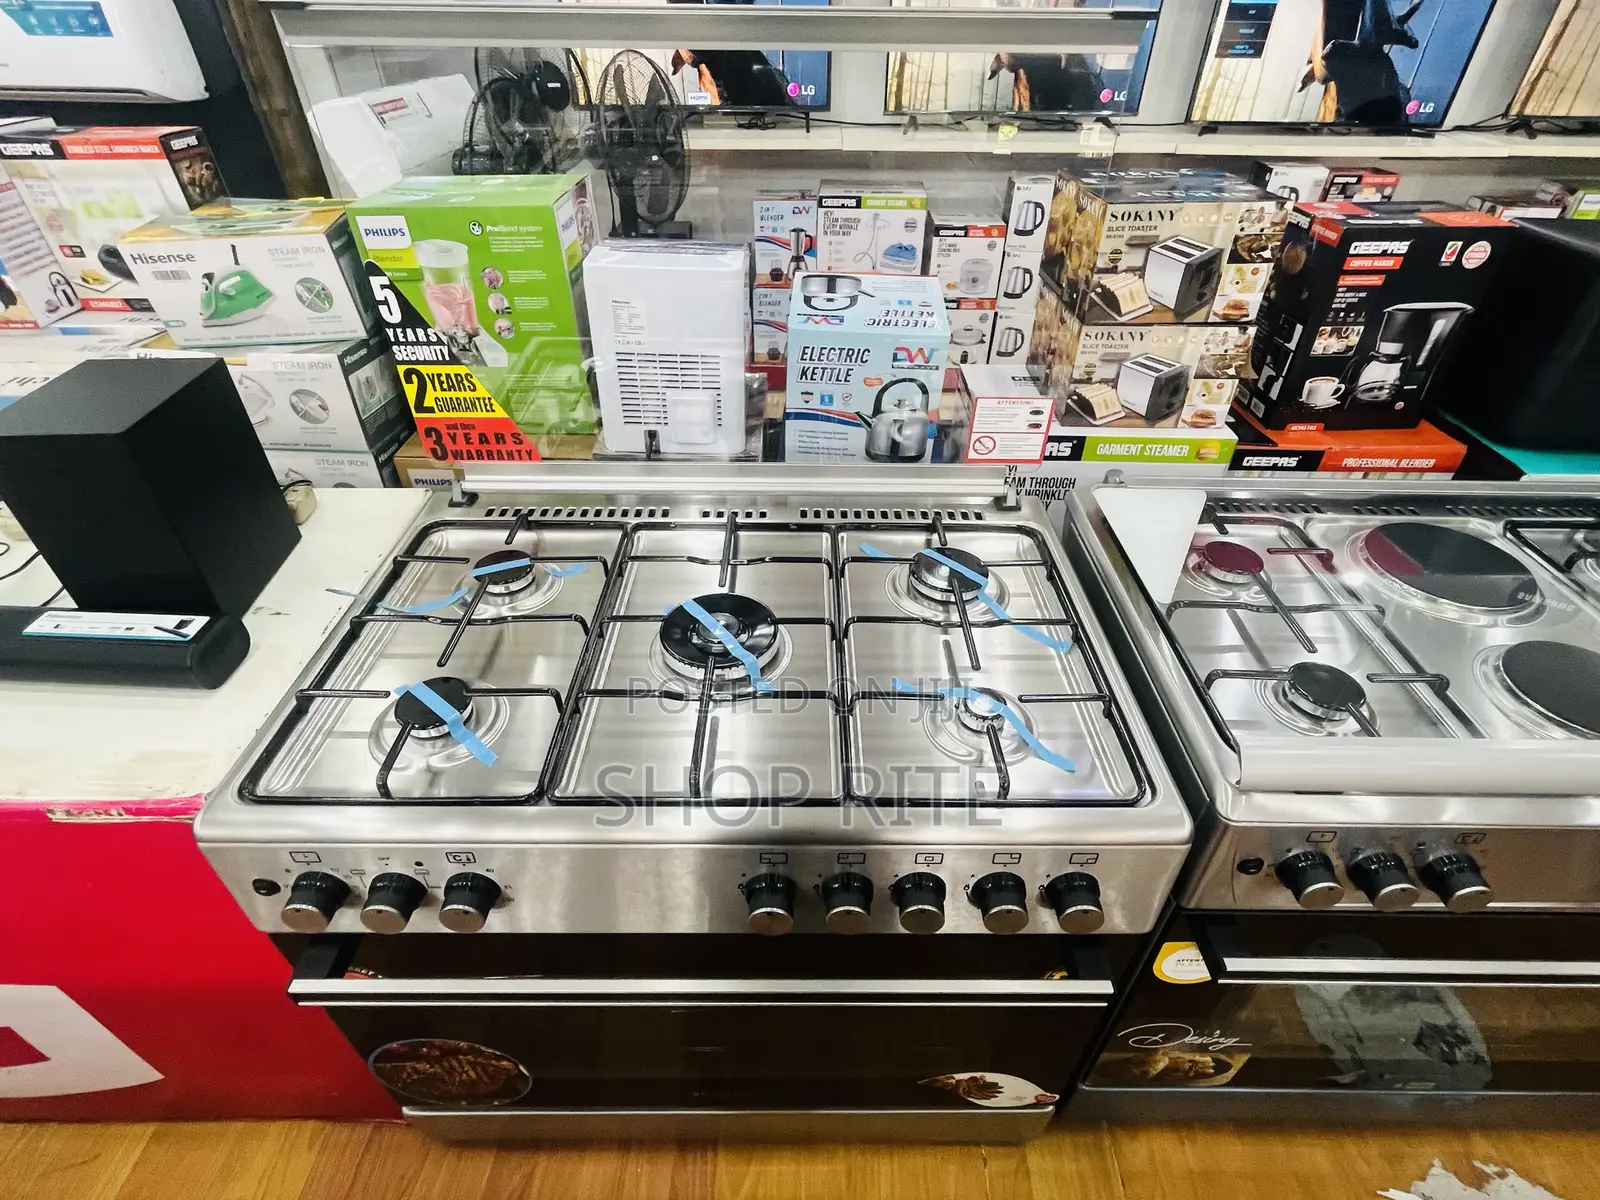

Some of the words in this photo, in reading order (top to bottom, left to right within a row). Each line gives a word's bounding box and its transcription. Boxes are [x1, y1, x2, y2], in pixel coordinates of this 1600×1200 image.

[801, 85, 815, 95] LG
[1114, 90, 1128, 101] LG
[1419, 103, 1435, 113] LG
[0, 144, 54, 155] GEEPAS
[822, 199, 857, 207] GEEPAS
[1109, 209, 1179, 222] SOKANY
[364, 228, 406, 237] PHILIPS
[486, 225, 517, 233] ProBlend
[519, 225, 543, 233] system
[268, 247, 301, 256] STEAM
[301, 246, 326, 254] IRON
[1349, 241, 1412, 254] GEEPAS
[131, 252, 196, 265] Hisense
[369, 276, 401, 323] 5
[385, 328, 438, 342] YEARS
[1084, 331, 1147, 341] SOKANY
[343, 347, 368, 366] Hisense
[392, 345, 450, 361] SECURITY
[799, 345, 871, 364] ELECTRIC
[272, 361, 306, 370] STEAM
[308, 361, 332, 370] IRON
[799, 366, 854, 382] KETTLE
[403, 368, 436, 414] 2
[427, 373, 477, 393] YEARS
[434, 397, 496, 413] GUARANTEE
[424, 427, 449, 461] 3
[447, 432, 524, 445] YEARS
[450, 450, 533, 461] WARRANTY
[1096, 443, 1142, 456] GARMENT
[1144, 444, 1189, 457] STEAMER
[315, 459, 346, 467] STEAM
[347, 459, 369, 467] IRON
[1242, 457, 1300, 467] GEEPAS
[1341, 458, 1398, 468] PROFESSIONAL
[1400, 458, 1436, 468] BLENDER
[414, 478, 453, 486] PHILIPS
[1030, 477, 1076, 489] THROUGH
